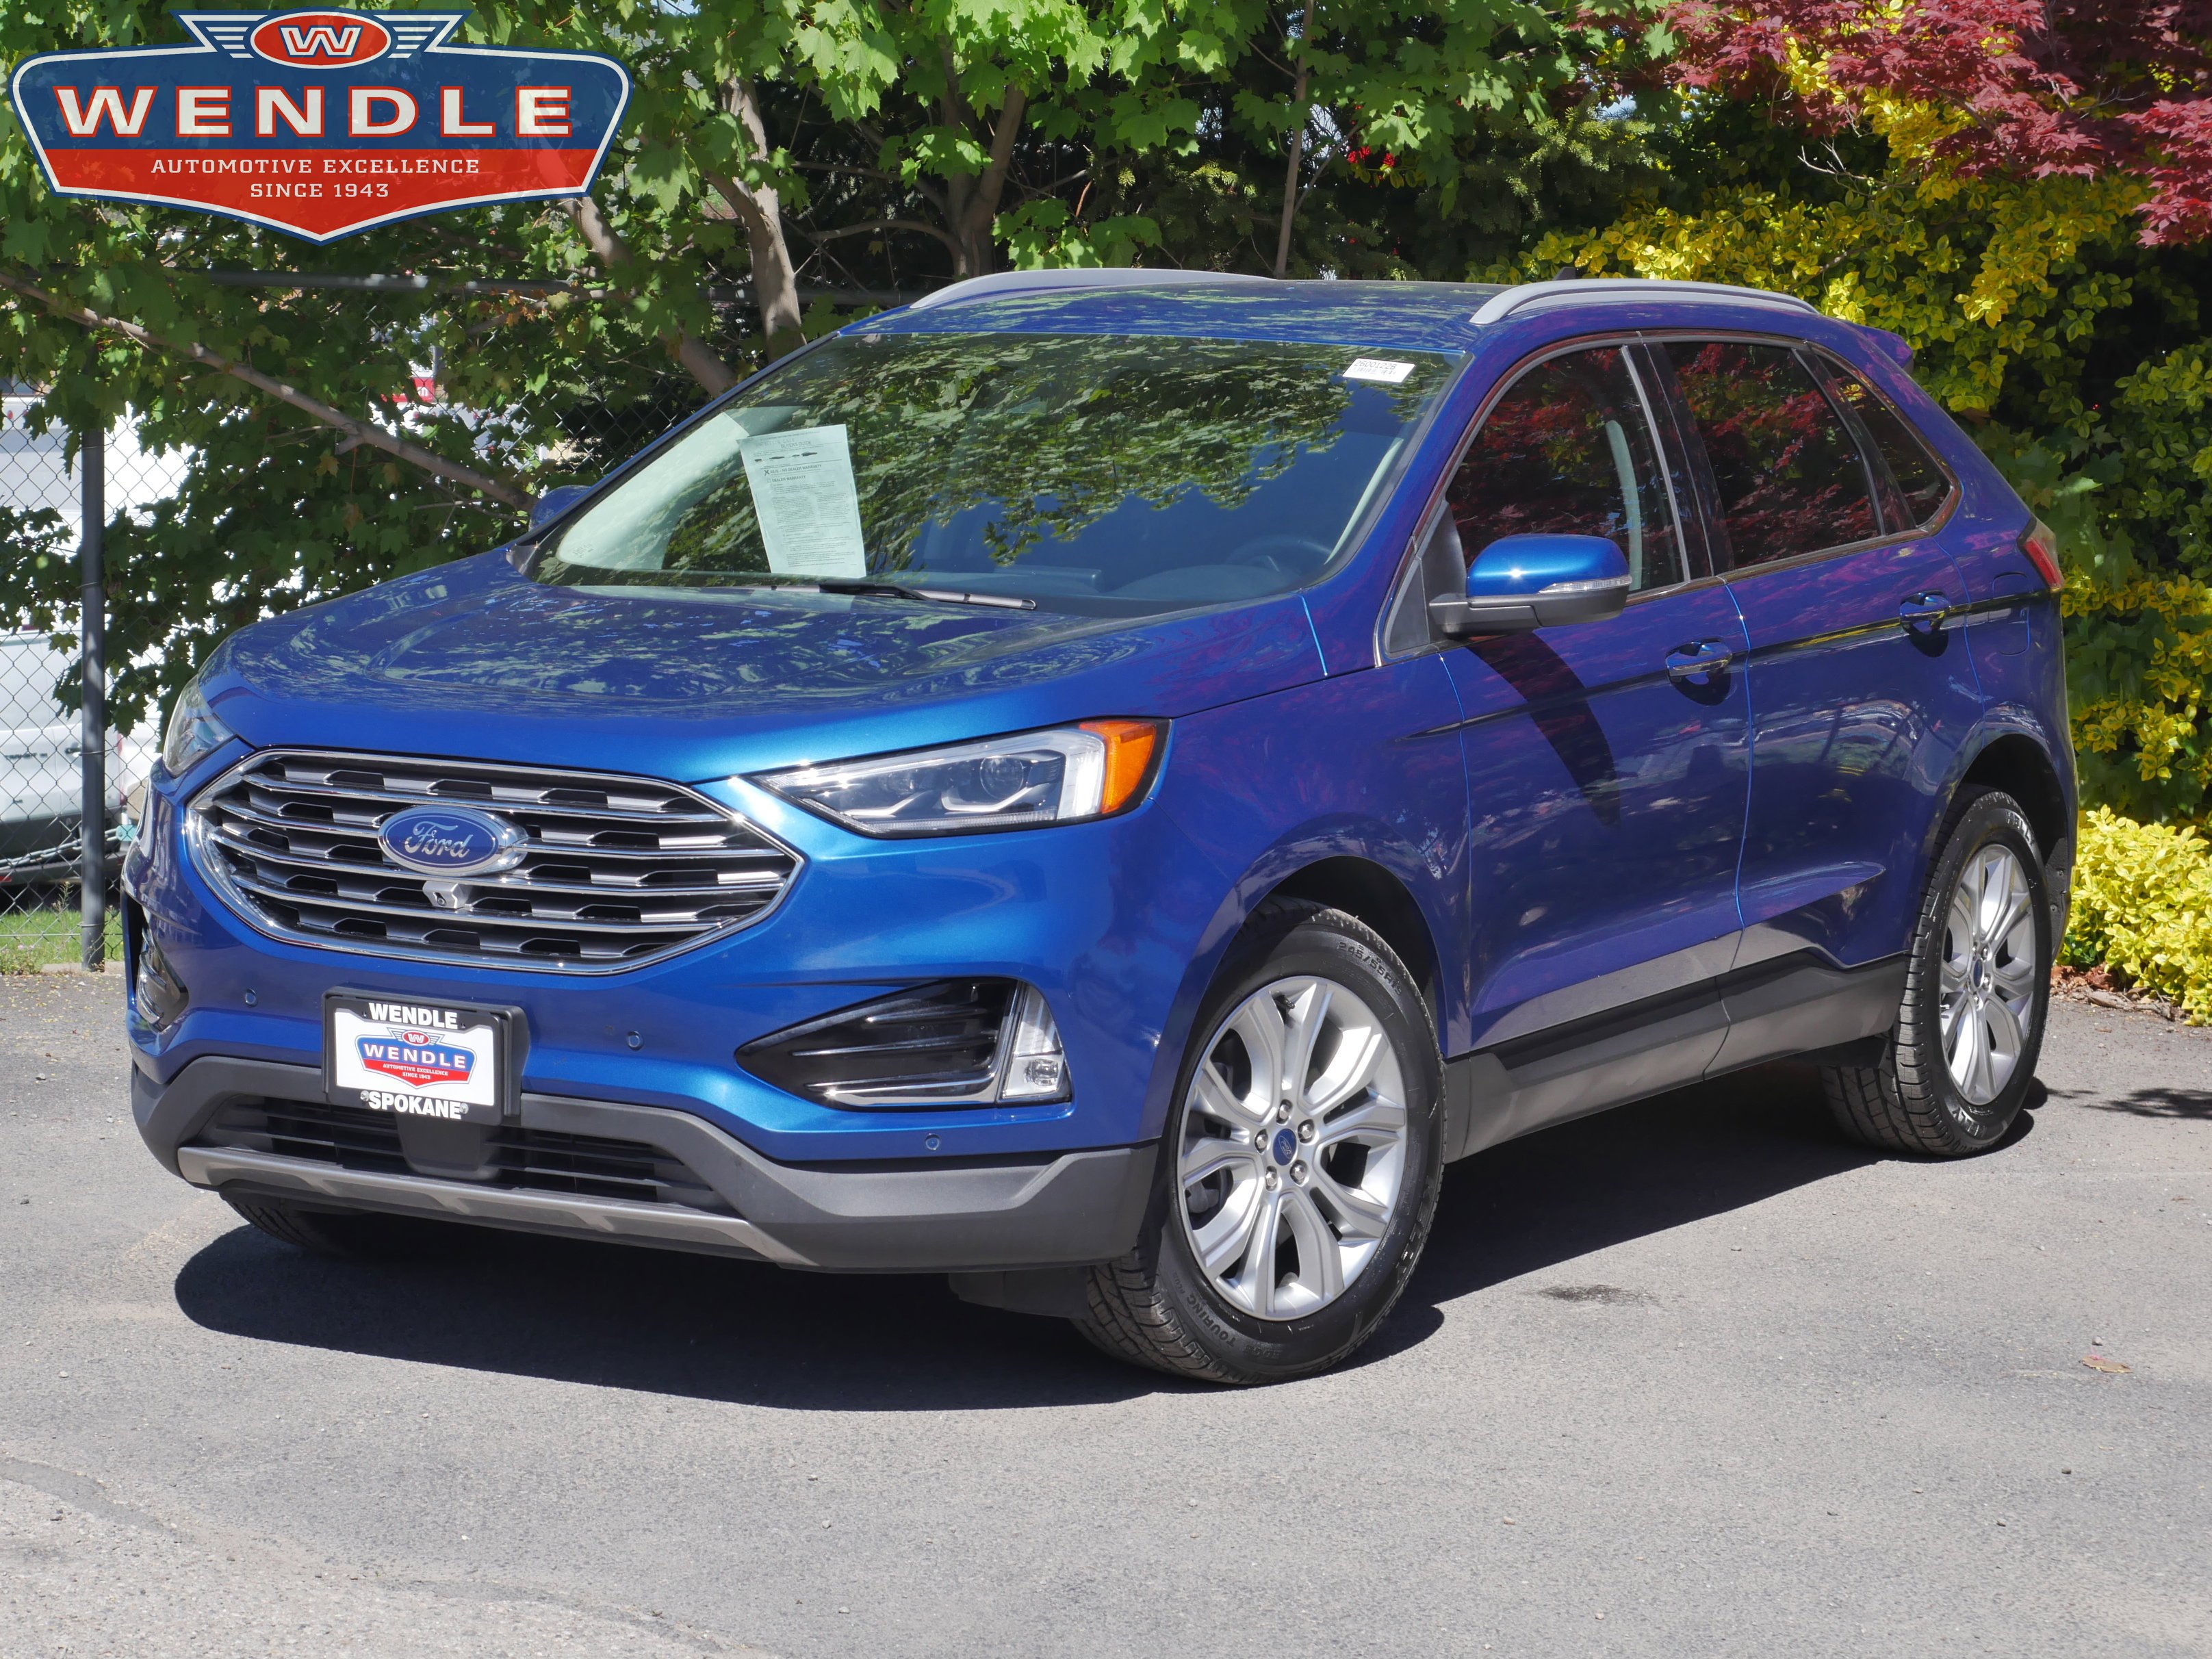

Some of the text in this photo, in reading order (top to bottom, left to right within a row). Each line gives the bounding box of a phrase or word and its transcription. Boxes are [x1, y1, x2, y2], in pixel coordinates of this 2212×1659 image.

[405, 821, 474, 858] Ford
[368, 1002, 458, 1029] WENDLE
[363, 1043, 466, 1069] WENDLE
[383, 1063, 448, 1076] AUTOMOTIVE EXCELLENCE
[368, 1090, 462, 1120] SPOKANE
[1187, 1294, 1236, 1347] TOURING
